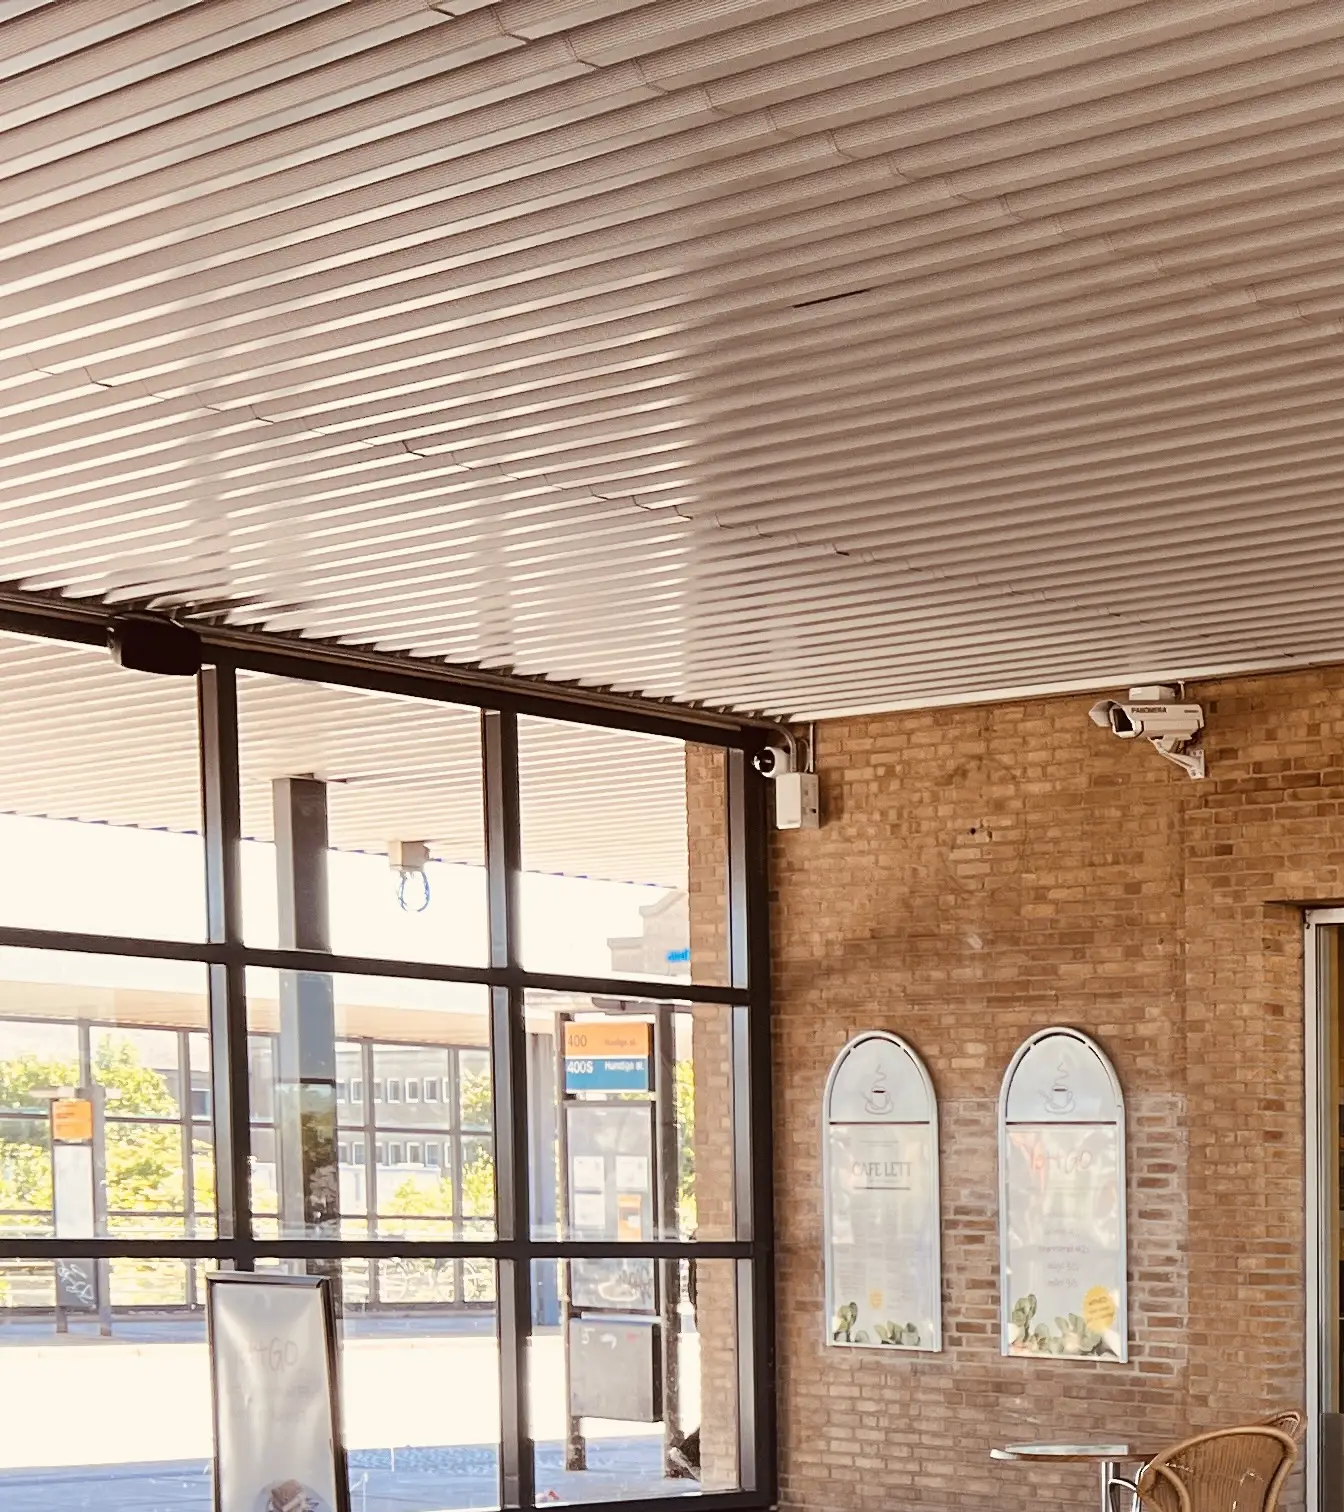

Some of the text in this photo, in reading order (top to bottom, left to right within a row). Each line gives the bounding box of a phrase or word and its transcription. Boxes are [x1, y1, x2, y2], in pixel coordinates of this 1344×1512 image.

[567, 1034, 588, 1047] 400
[567, 1060, 594, 1073] 400S
[852, 1161, 912, 1177] CAFE LETT
